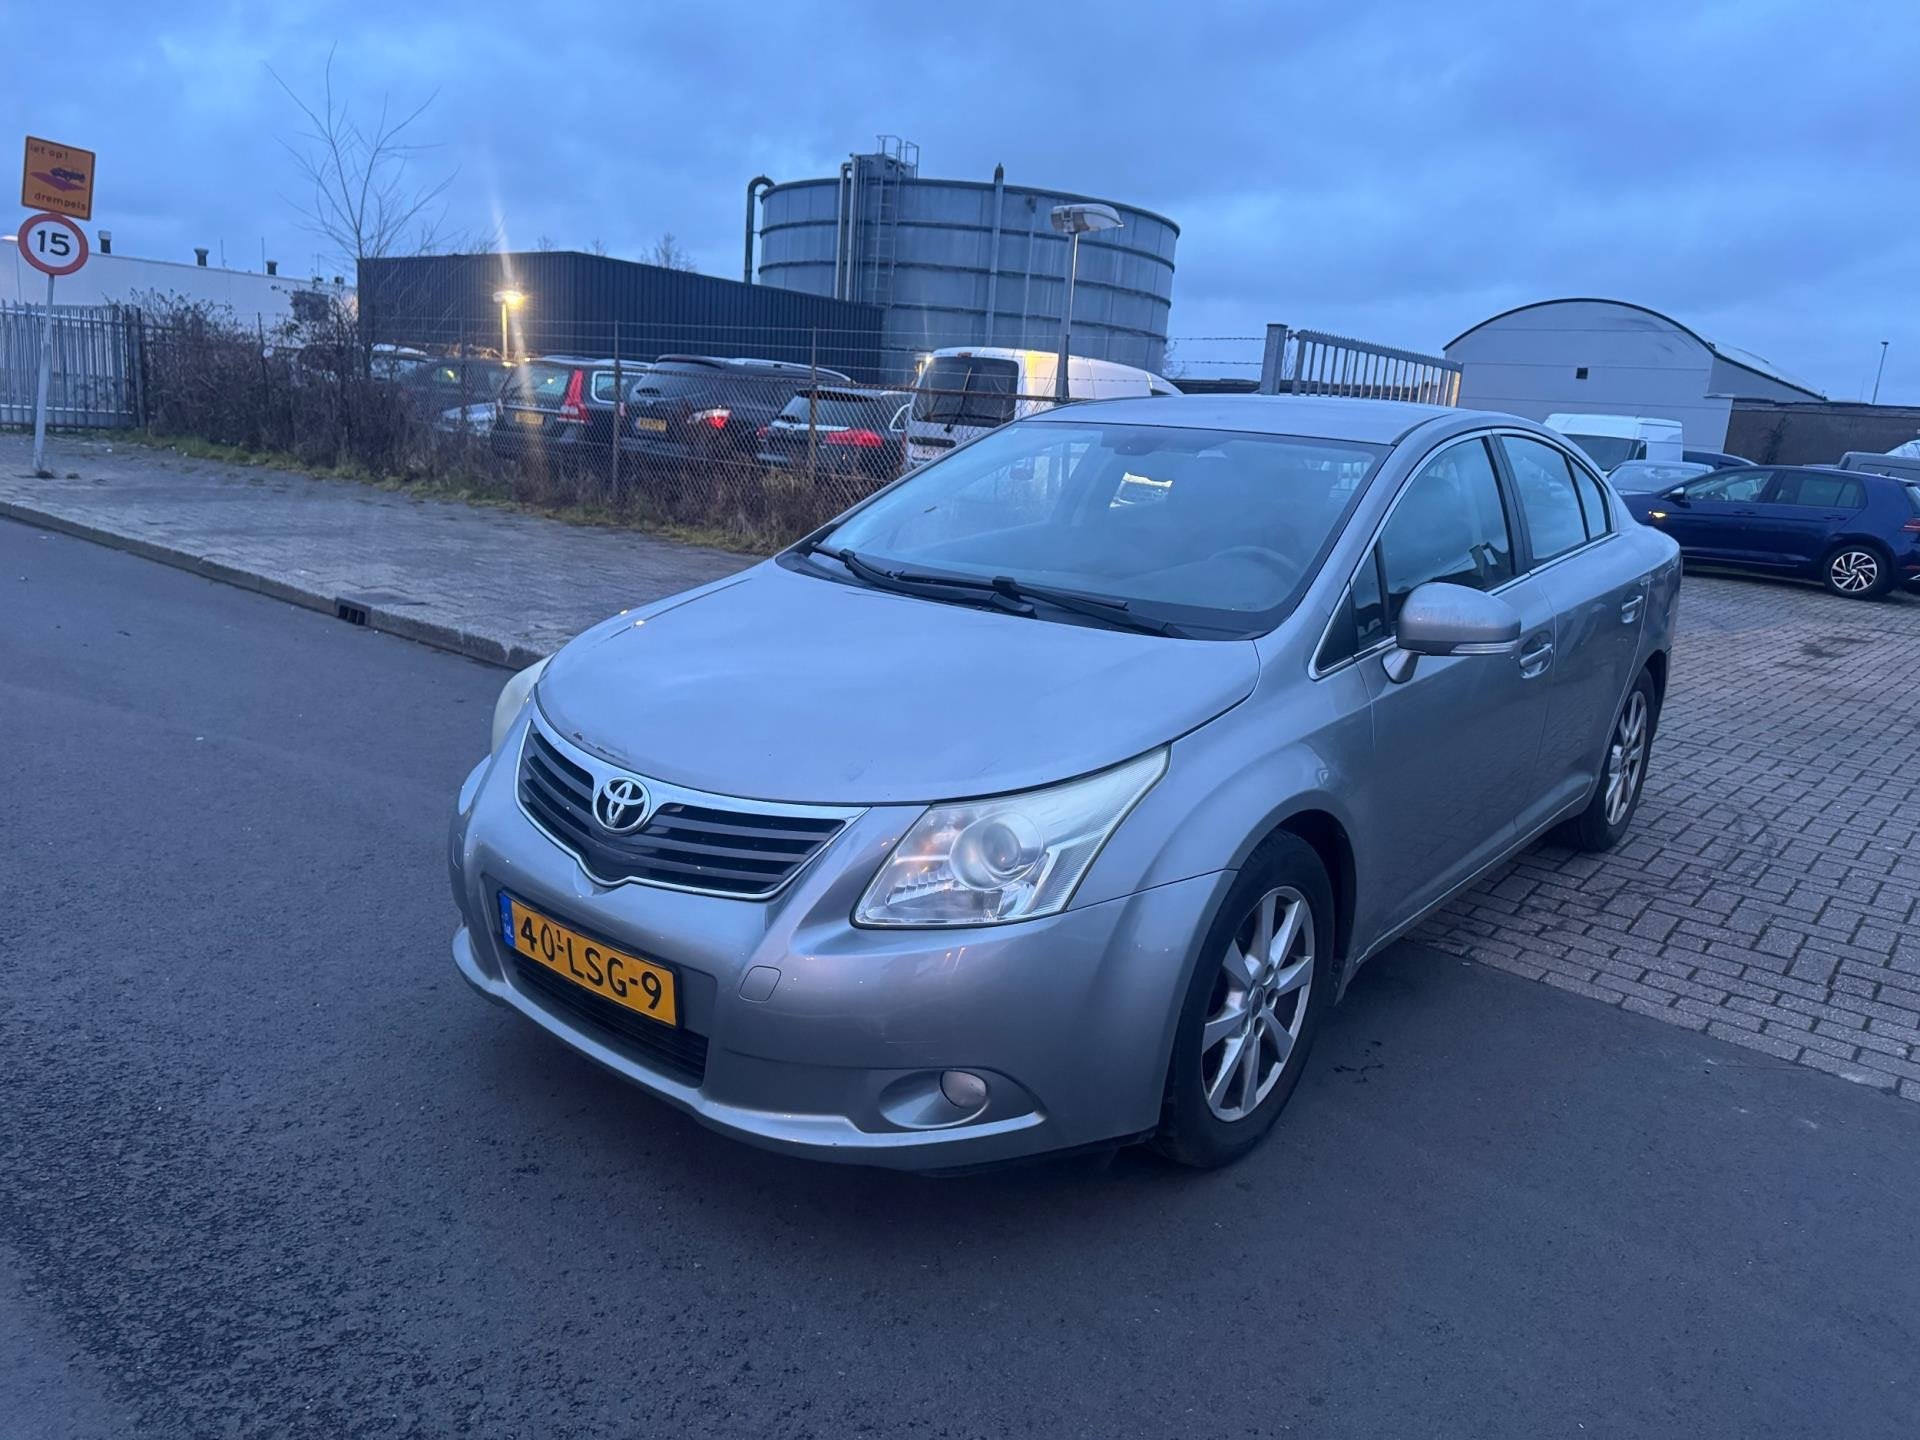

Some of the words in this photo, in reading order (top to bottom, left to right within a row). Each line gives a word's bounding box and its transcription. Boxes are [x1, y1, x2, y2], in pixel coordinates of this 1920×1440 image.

[34, 192, 87, 211] drempels
[37, 229, 70, 256] 15
[520, 916, 662, 1010] 40-LSG-9
